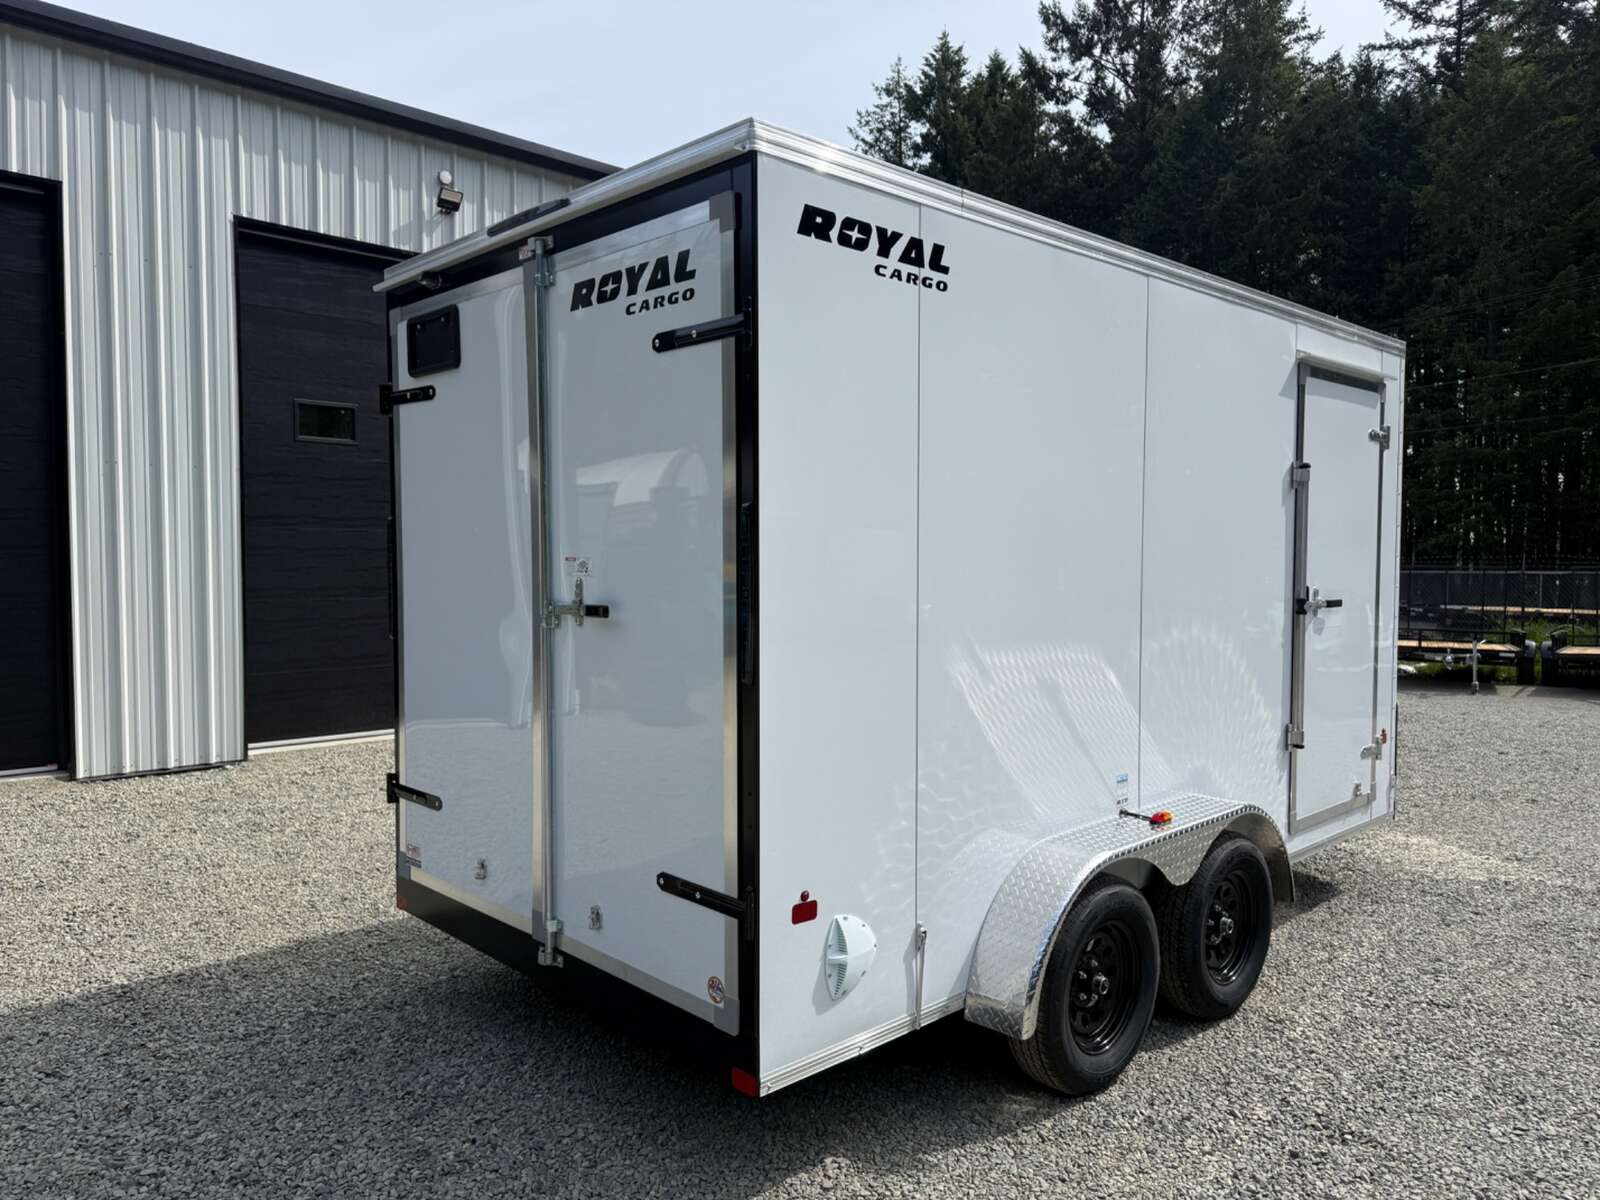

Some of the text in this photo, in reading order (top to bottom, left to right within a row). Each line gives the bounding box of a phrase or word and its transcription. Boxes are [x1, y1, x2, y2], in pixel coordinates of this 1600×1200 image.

[797, 203, 950, 276] ROYAL
[570, 248, 697, 313] ROYAL
[625, 287, 696, 316] CARGO
[874, 264, 948, 292] CARGO
